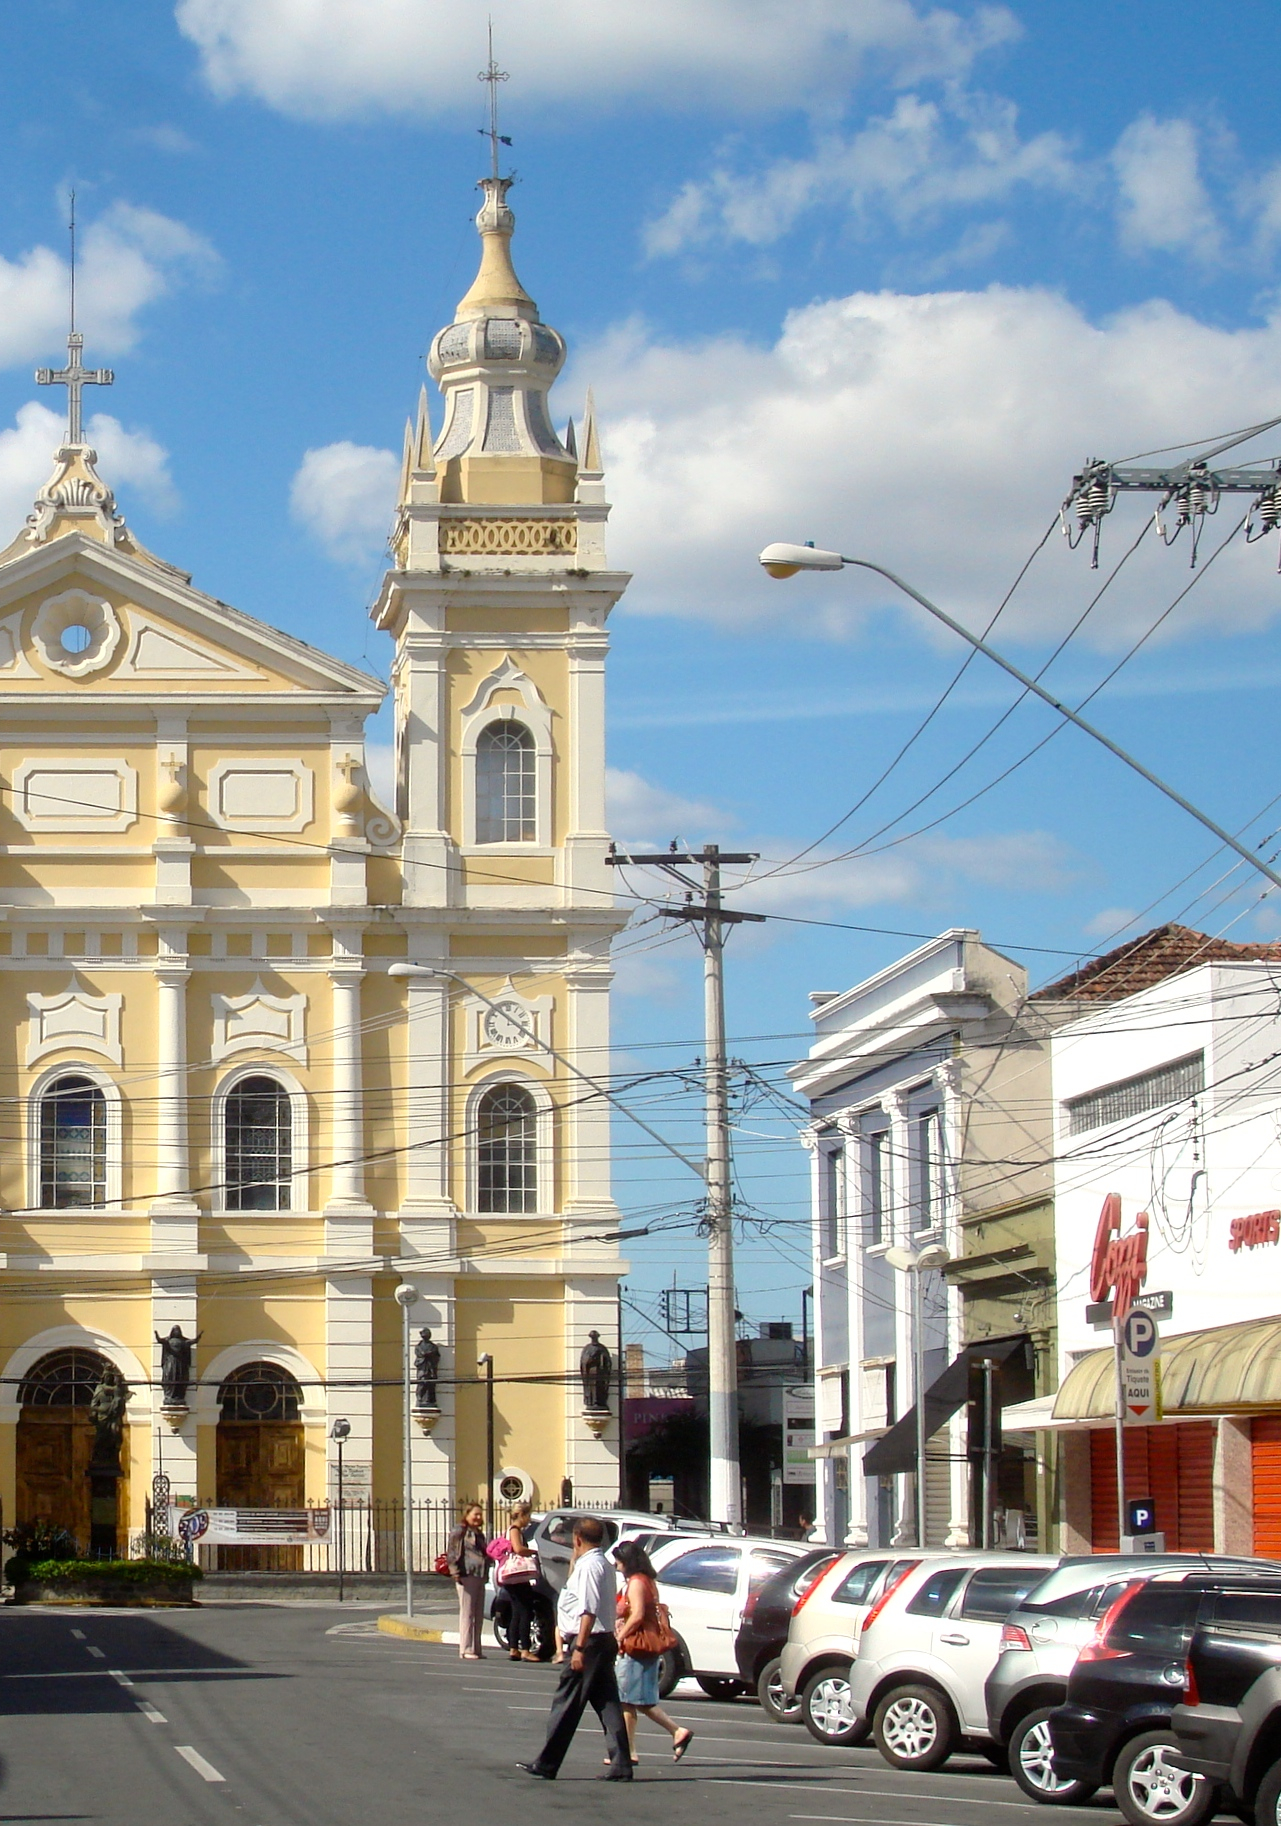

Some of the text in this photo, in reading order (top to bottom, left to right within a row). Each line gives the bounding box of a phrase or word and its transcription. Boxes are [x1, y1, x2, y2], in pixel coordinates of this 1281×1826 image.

[1229, 1210, 1281, 1251] SPORTS
[1130, 1317, 1152, 1352] P
[1128, 1388, 1149, 1398] AQUI
[1136, 1509, 1148, 1526] P
